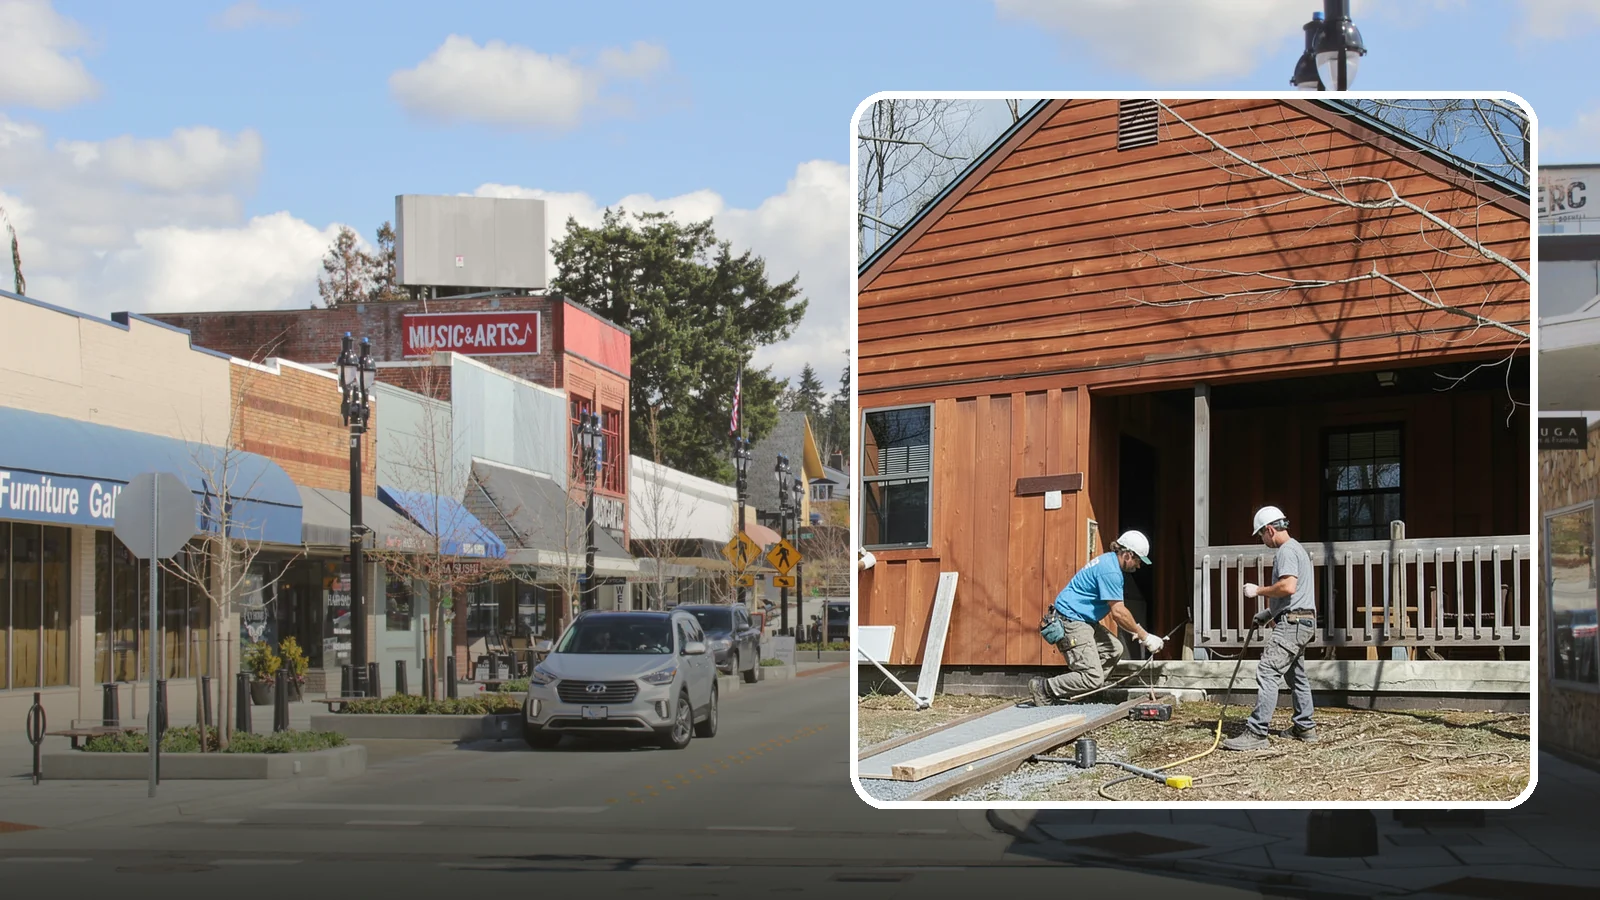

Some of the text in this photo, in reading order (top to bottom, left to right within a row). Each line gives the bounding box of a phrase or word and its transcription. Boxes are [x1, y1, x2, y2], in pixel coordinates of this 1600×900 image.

[409, 323, 519, 348] MUSIC&ARTS
[0, 471, 122, 519] Furniture Gal
[453, 564, 479, 574] SUSHI
